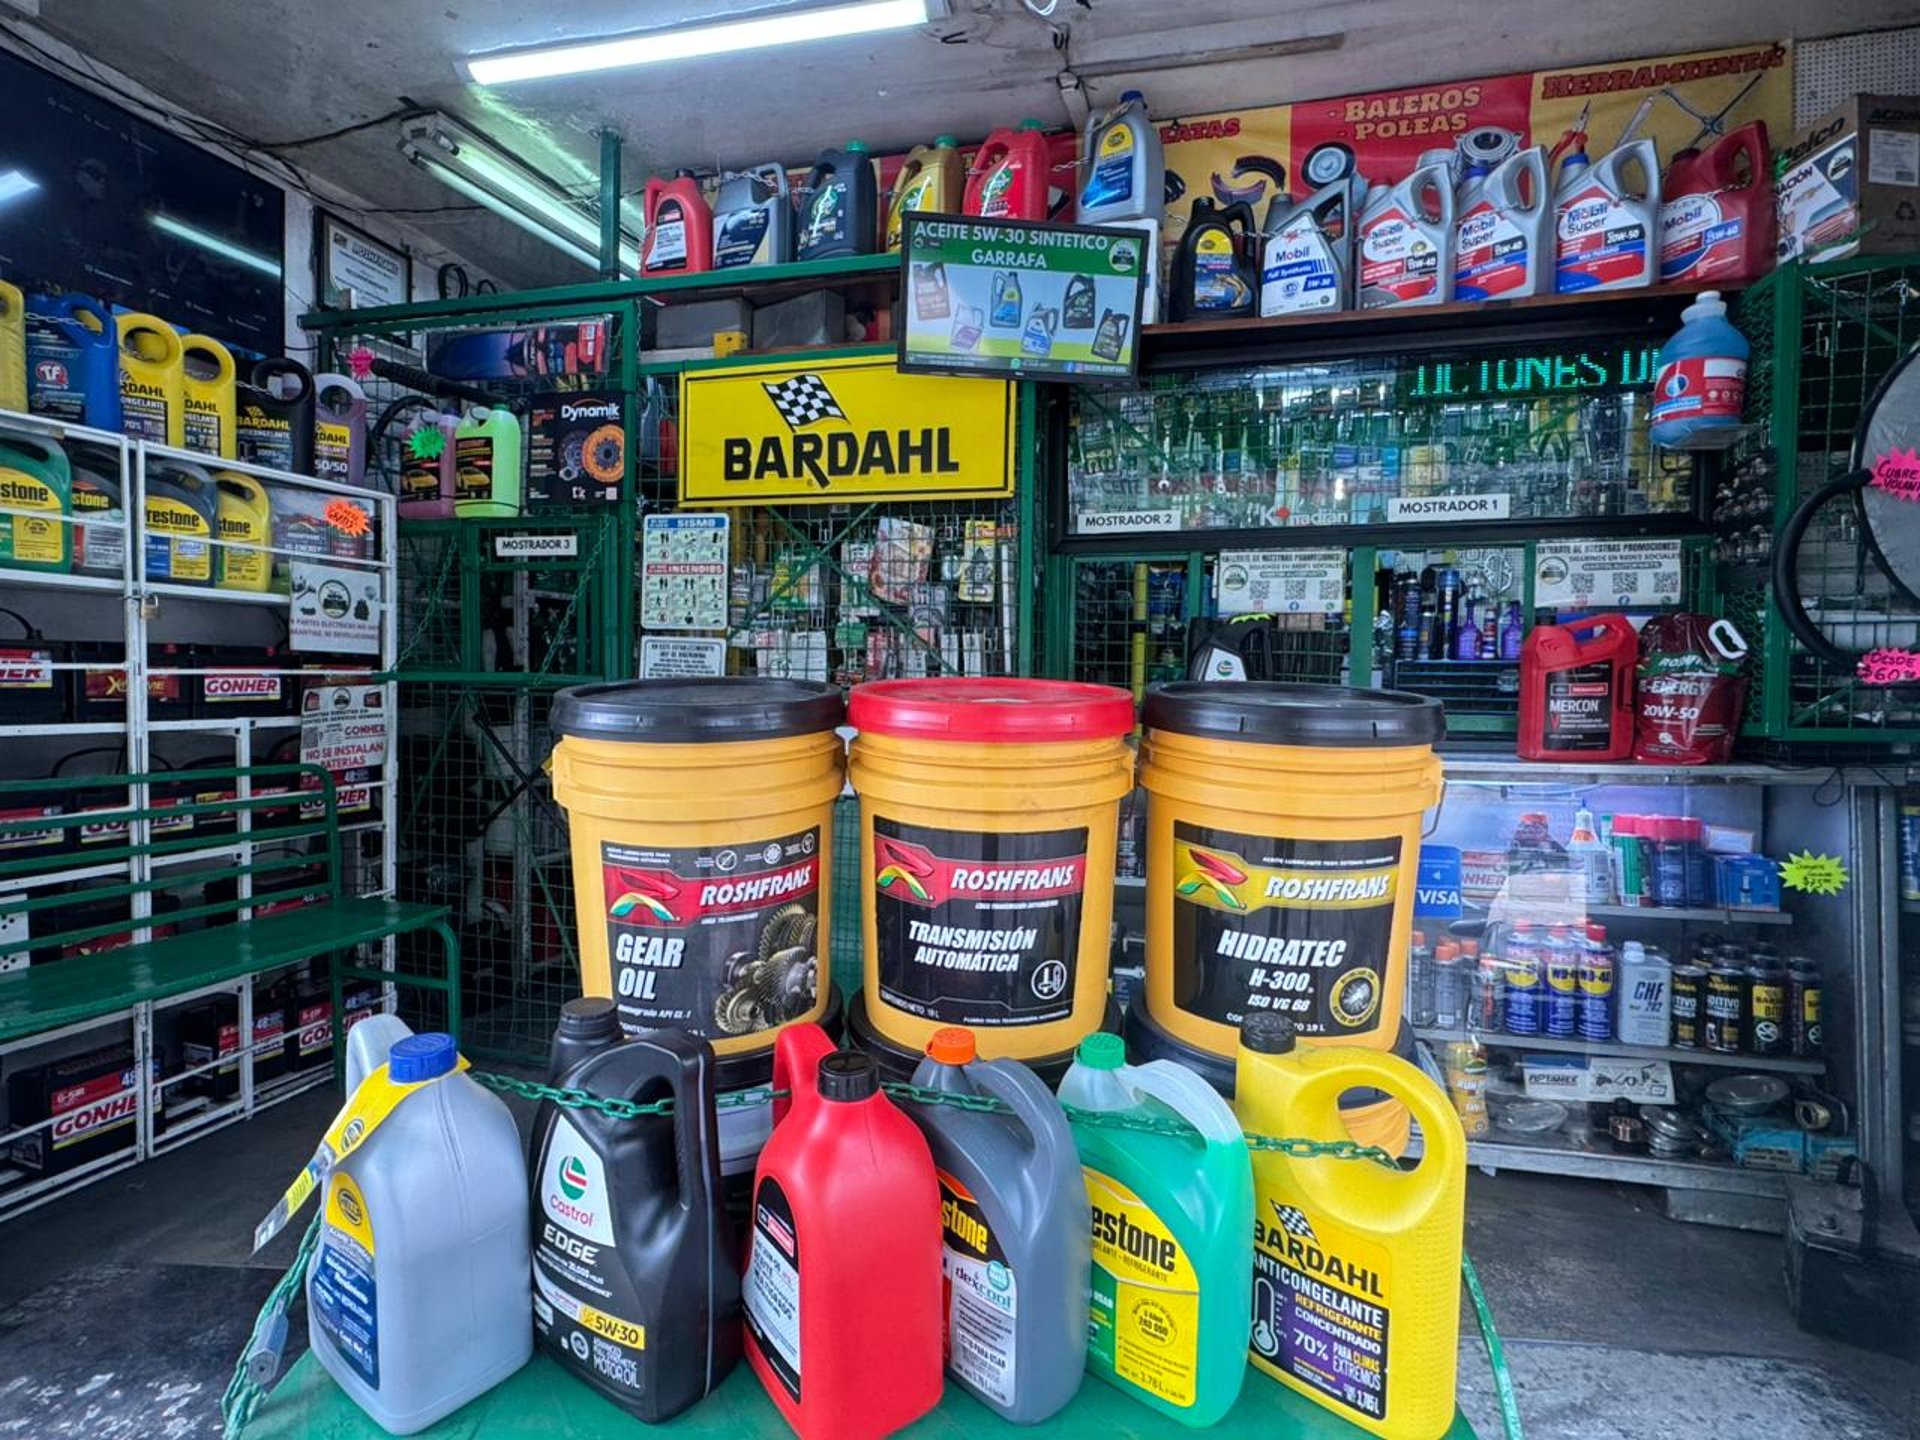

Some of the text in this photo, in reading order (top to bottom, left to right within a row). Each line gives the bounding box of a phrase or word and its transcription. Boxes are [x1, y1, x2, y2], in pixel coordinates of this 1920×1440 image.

[1344, 86, 1482, 122] BALEROS
[1354, 113, 1468, 140] POLEAS
[1462, 215, 1496, 236] Mobil
[1567, 216, 1607, 234] Super
[1664, 206, 1703, 231] Mobil
[914, 222, 968, 239] ACEITE
[973, 227, 1024, 244] 5W-30
[1030, 231, 1108, 250] SINTETICO
[1372, 235, 1403, 251] Super
[1462, 230, 1495, 250] Super
[971, 249, 1048, 269] GARRAFA
[1275, 246, 1310, 263] Mobil
[561, 403, 621, 422] Dynamik
[314, 458, 348, 473] 50/50
[723, 426, 960, 490] BARDAHL
[1397, 499, 1498, 515] MOSTRADOR 1
[1085, 513, 1172, 528] MOSTRADOR 2
[502, 539, 571, 551] MOSTRADOR 3
[206, 677, 278, 694] GONHER
[1550, 700, 1600, 713] MERCON
[306, 743, 385, 760] NO SE INSTALAN
[699, 865, 812, 907] ROSHFRANS
[951, 865, 1076, 892] ROSHFRANS
[1264, 875, 1391, 901] ROSHFRANS
[1418, 889, 1461, 906] VISA
[908, 920, 1038, 952] TRANSMISIÓN
[1216, 929, 1347, 968] HIDRATEC
[616, 932, 686, 968] GEAR
[914, 946, 1021, 973] AUTOMÁTICA
[617, 967, 657, 1001] OIL
[1249, 968, 1311, 992] H-300
[1634, 980, 1666, 1002] CHF
[1247, 994, 1270, 1008] ISO
[1271, 997, 1291, 1010] VG
[550, 1194, 594, 1227] Castrol
[543, 1223, 601, 1265] EDGE
[1091, 1203, 1177, 1274] estone
[1255, 1218, 1384, 1299] BARDAHL
[955, 1265, 1012, 1309] dexcool
[1253, 1254, 1384, 1330] ANTICONGELANTE
[595, 1315, 640, 1345] 5W-30
[1295, 1293, 1383, 1343] REFRIGERANTE
[1295, 1307, 1382, 1355] CONCENTRADO
[1293, 1327, 1330, 1362] 70%
[1333, 1341, 1353, 1361] PARA
[623, 1368, 641, 1389] OIL
[1333, 1357, 1382, 1392] EXTREMOS
